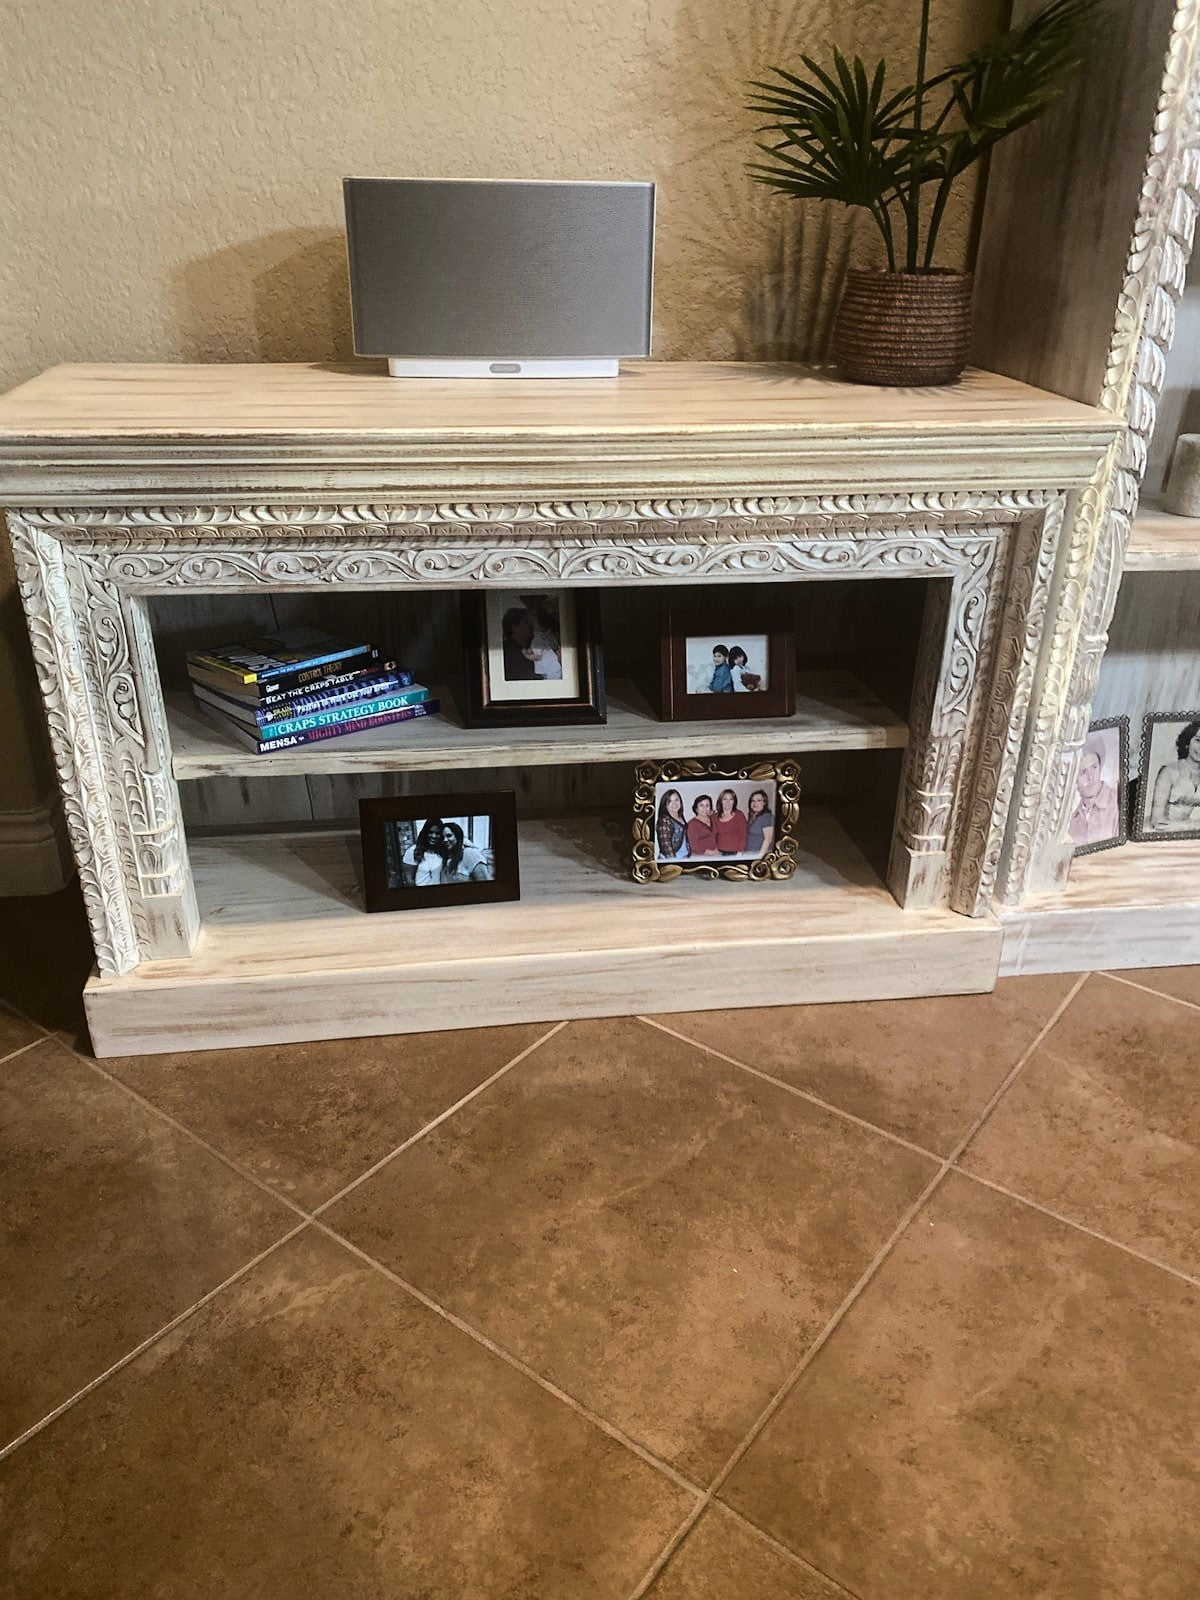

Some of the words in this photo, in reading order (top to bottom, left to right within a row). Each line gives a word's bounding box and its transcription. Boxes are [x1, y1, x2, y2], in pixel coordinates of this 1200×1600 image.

[265, 694, 286, 705] BEAT
[287, 687, 304, 697] THE
[304, 682, 330, 693] CRAPS
[331, 674, 354, 687] TABLE
[278, 718, 316, 735] CRAPS
[319, 703, 376, 724] STRATEGY
[378, 696, 409, 711] BOOK
[308, 725, 342, 741] MIGHTY
[345, 719, 368, 732] MIND
[259, 736, 298, 752] MENSA
